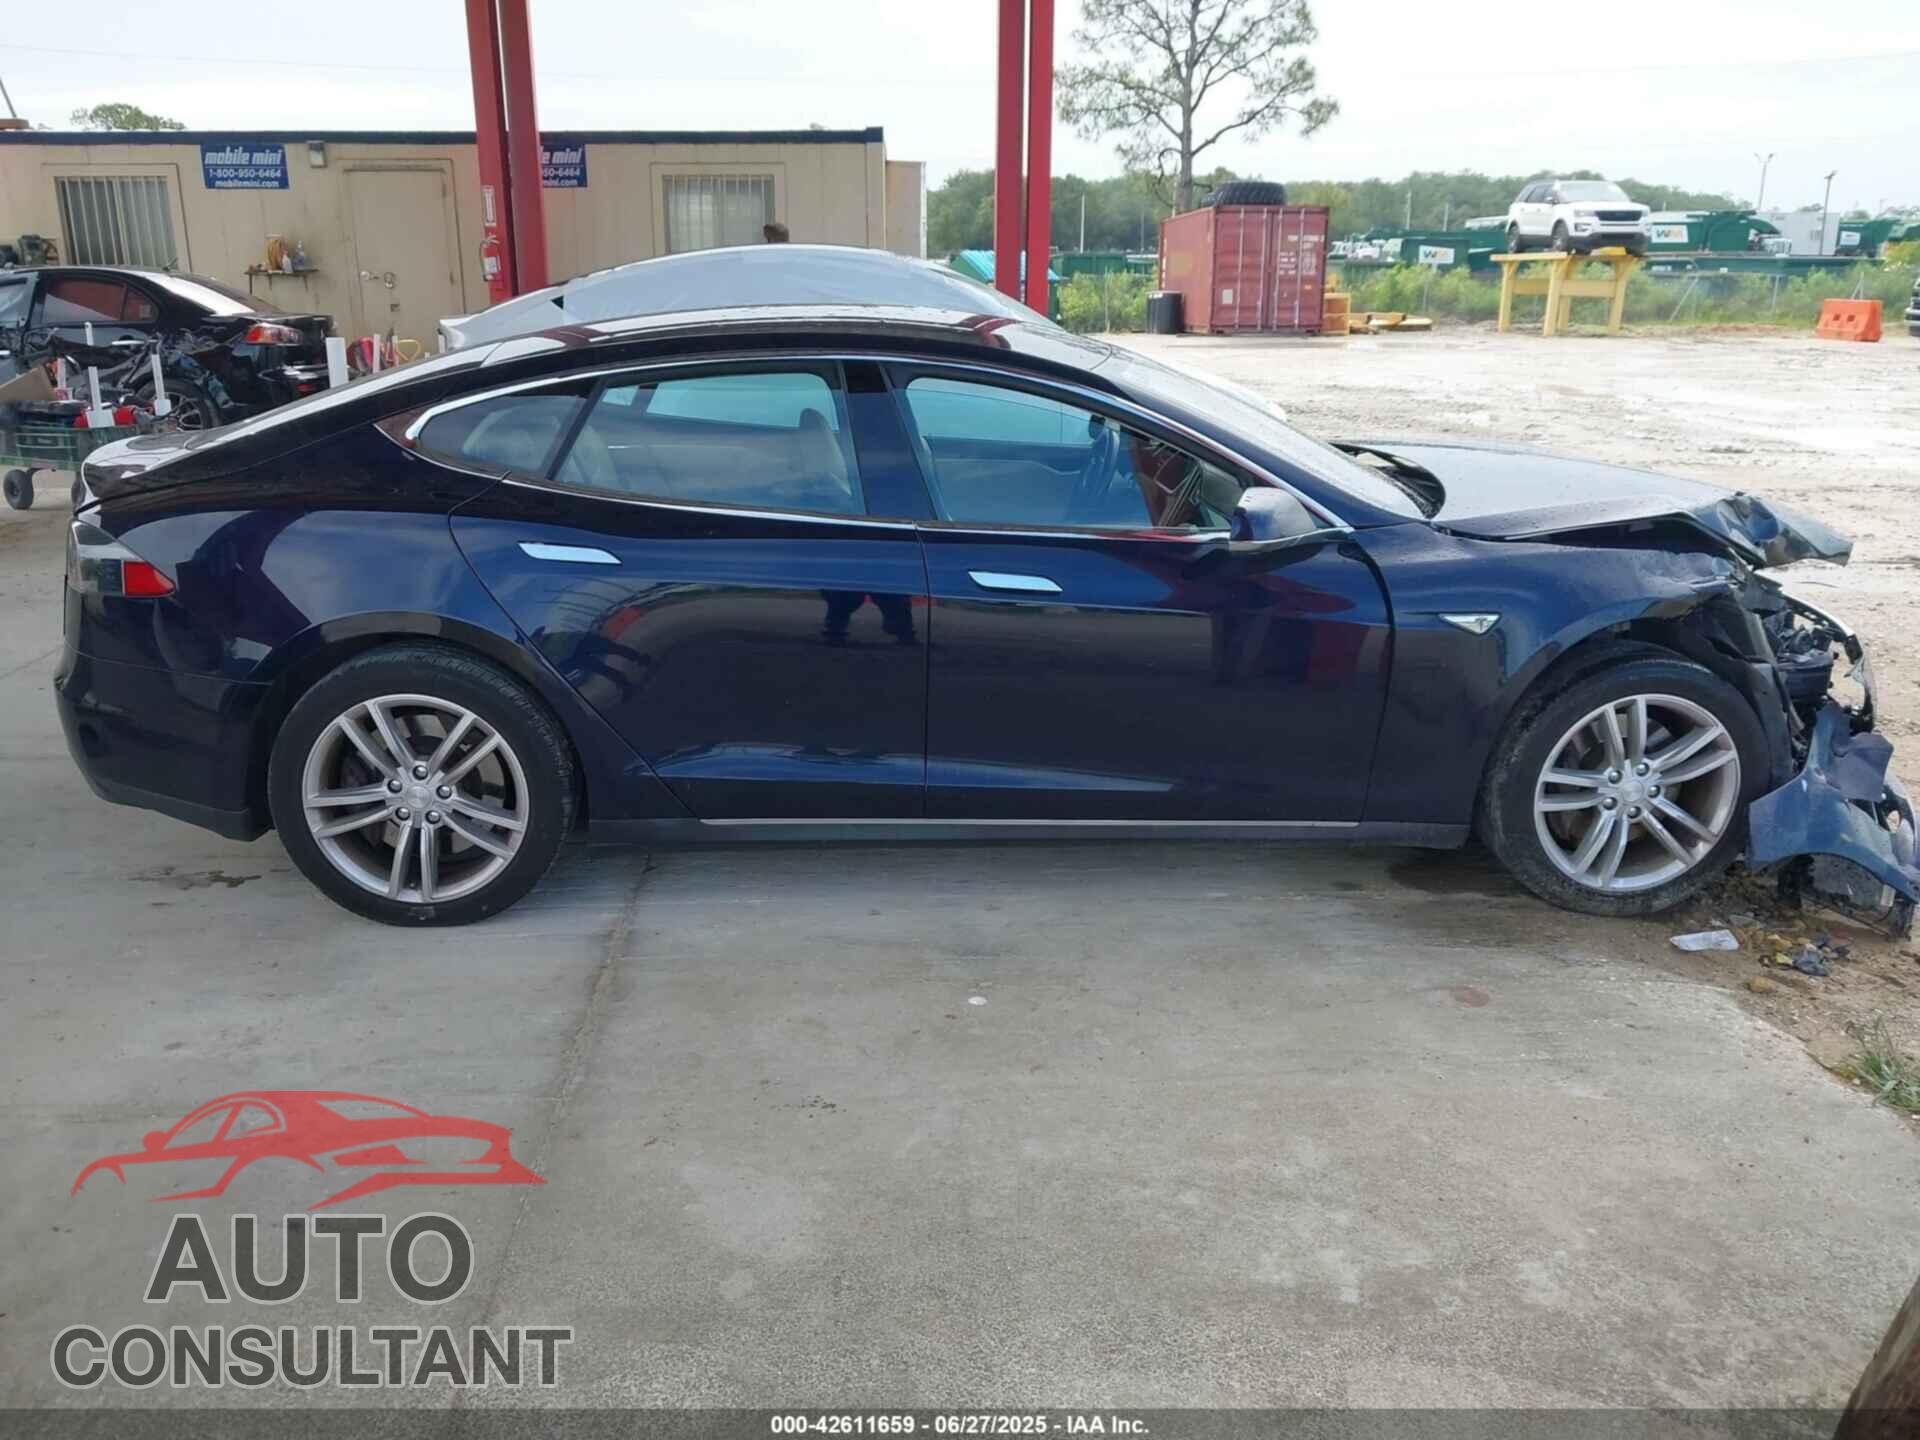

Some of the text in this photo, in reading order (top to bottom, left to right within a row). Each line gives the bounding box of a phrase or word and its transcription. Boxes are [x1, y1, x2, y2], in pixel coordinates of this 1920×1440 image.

[204, 146, 282, 164] mobile mini
[552, 148, 582, 164] mini
[209, 168, 281, 177] 1-800-950-6464
[543, 168, 580, 177] 50-6464
